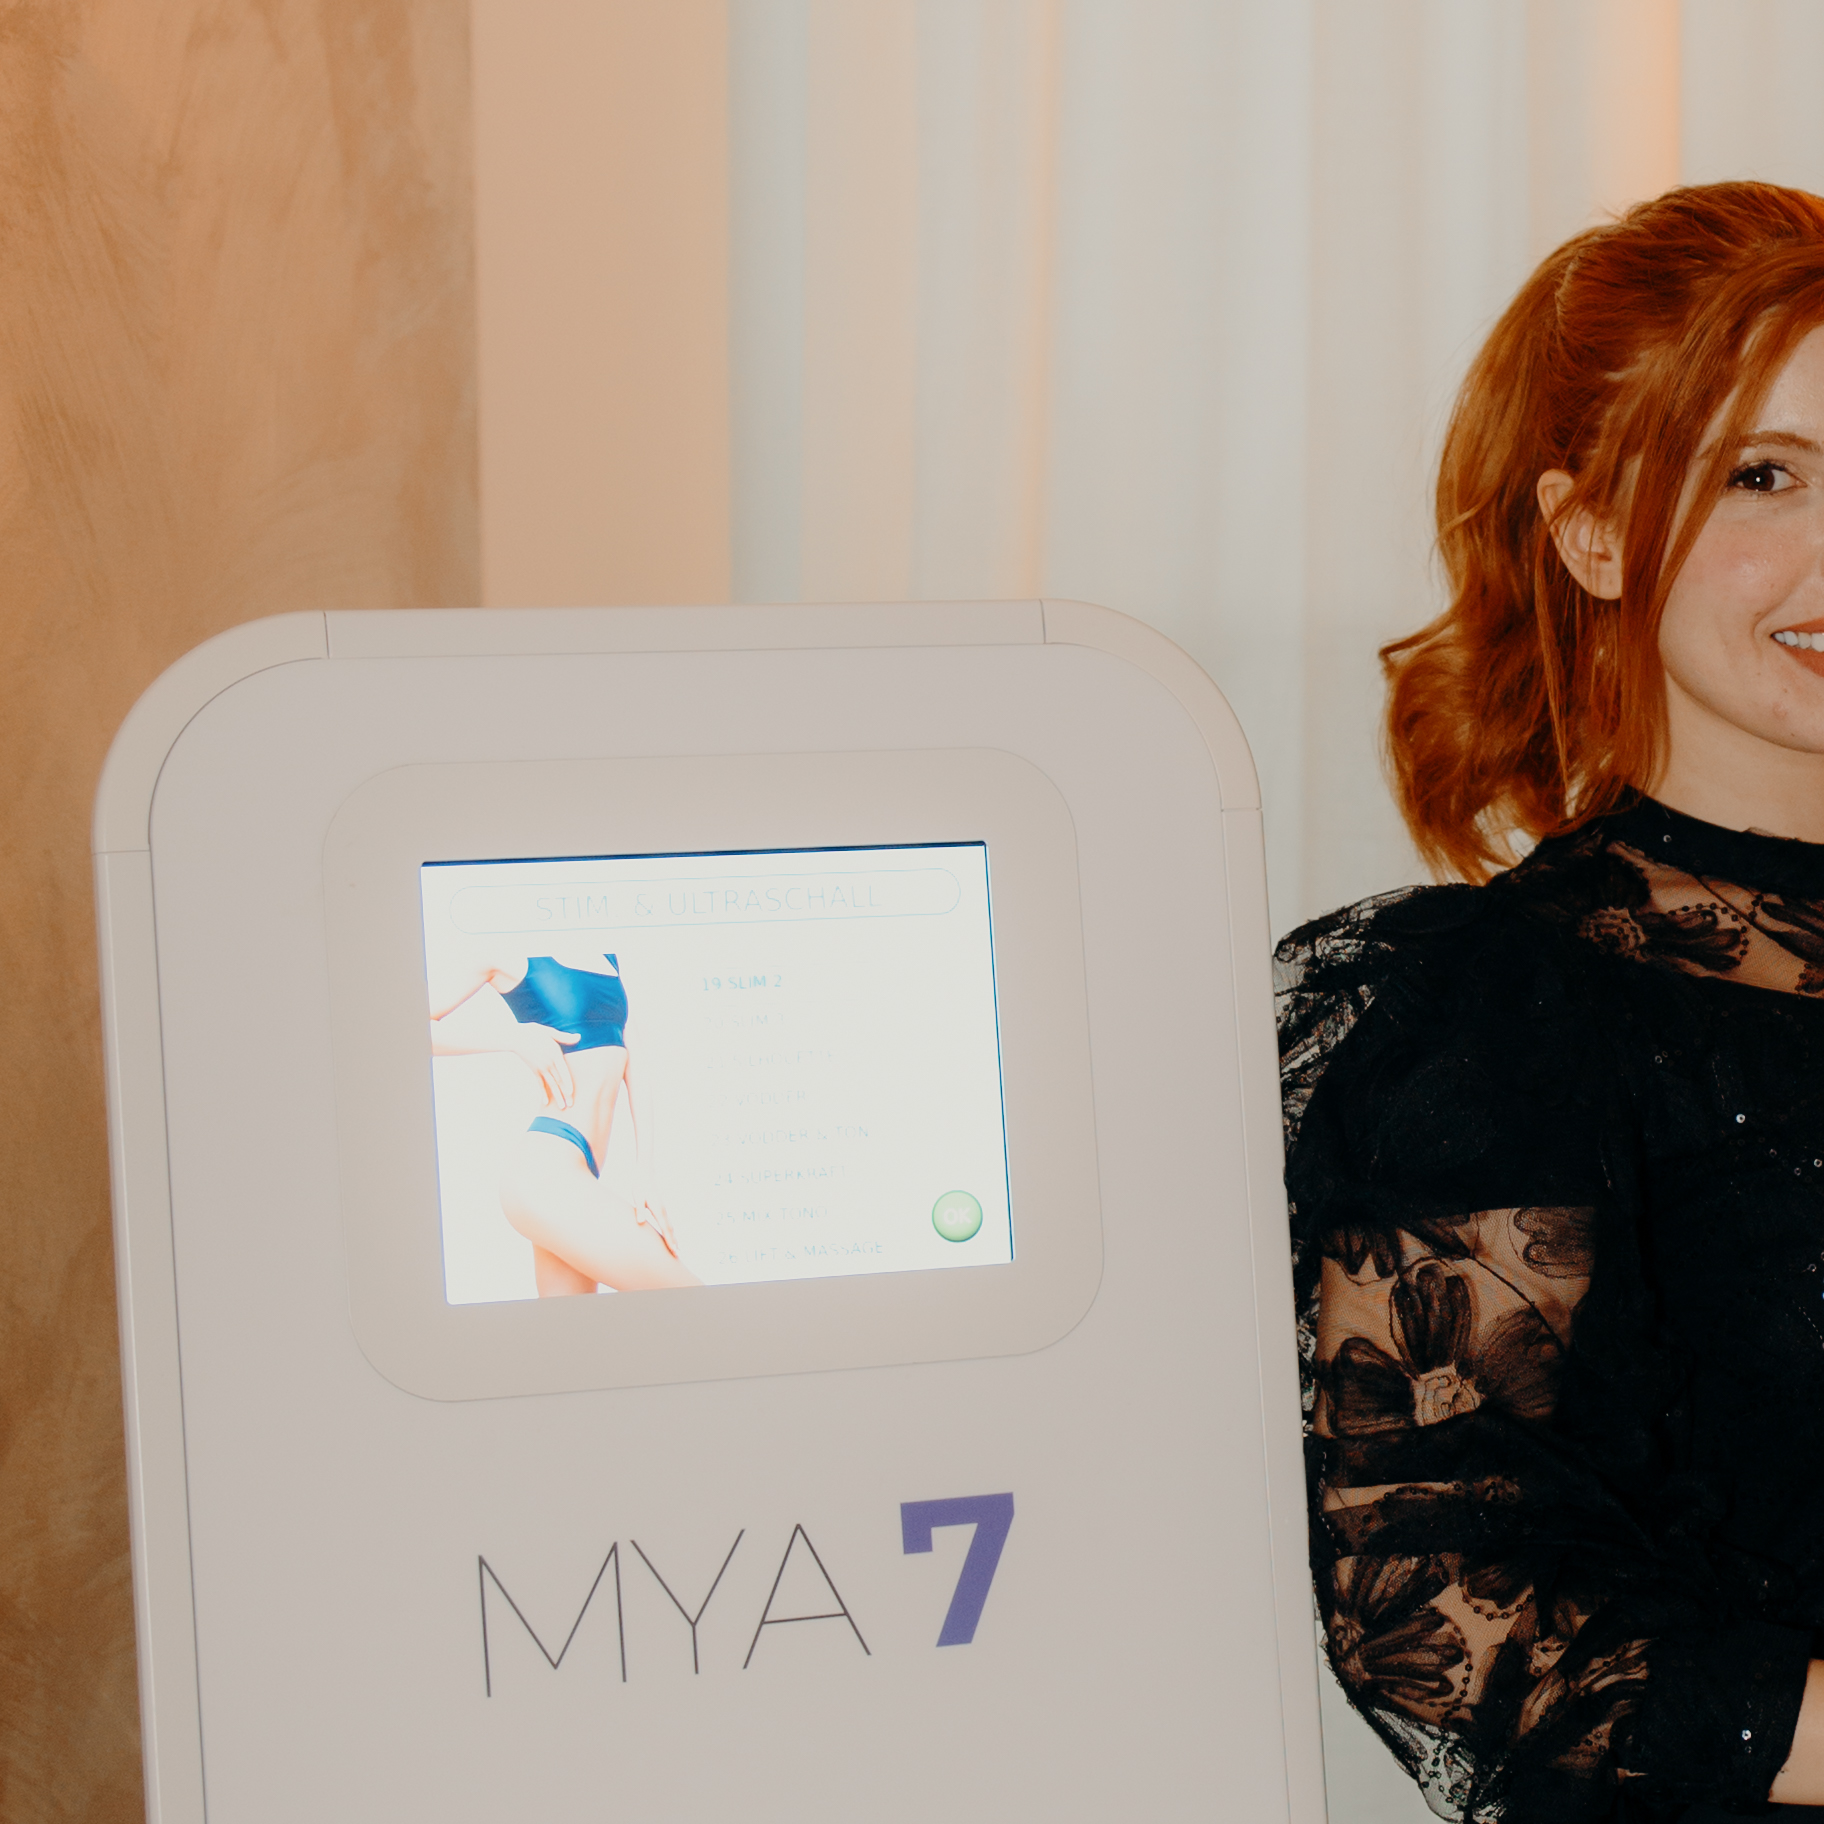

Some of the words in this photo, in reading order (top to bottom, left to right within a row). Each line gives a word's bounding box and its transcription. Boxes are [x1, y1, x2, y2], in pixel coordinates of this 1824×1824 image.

[634, 893, 655, 917] &
[667, 885, 883, 916] ULTRASCHALL
[702, 976, 723, 992] 19
[727, 974, 768, 991] SLIM
[774, 974, 783, 988] 2
[943, 1207, 972, 1226] OK
[477, 1523, 872, 1698] MYA
[899, 1491, 1016, 1649] 7
